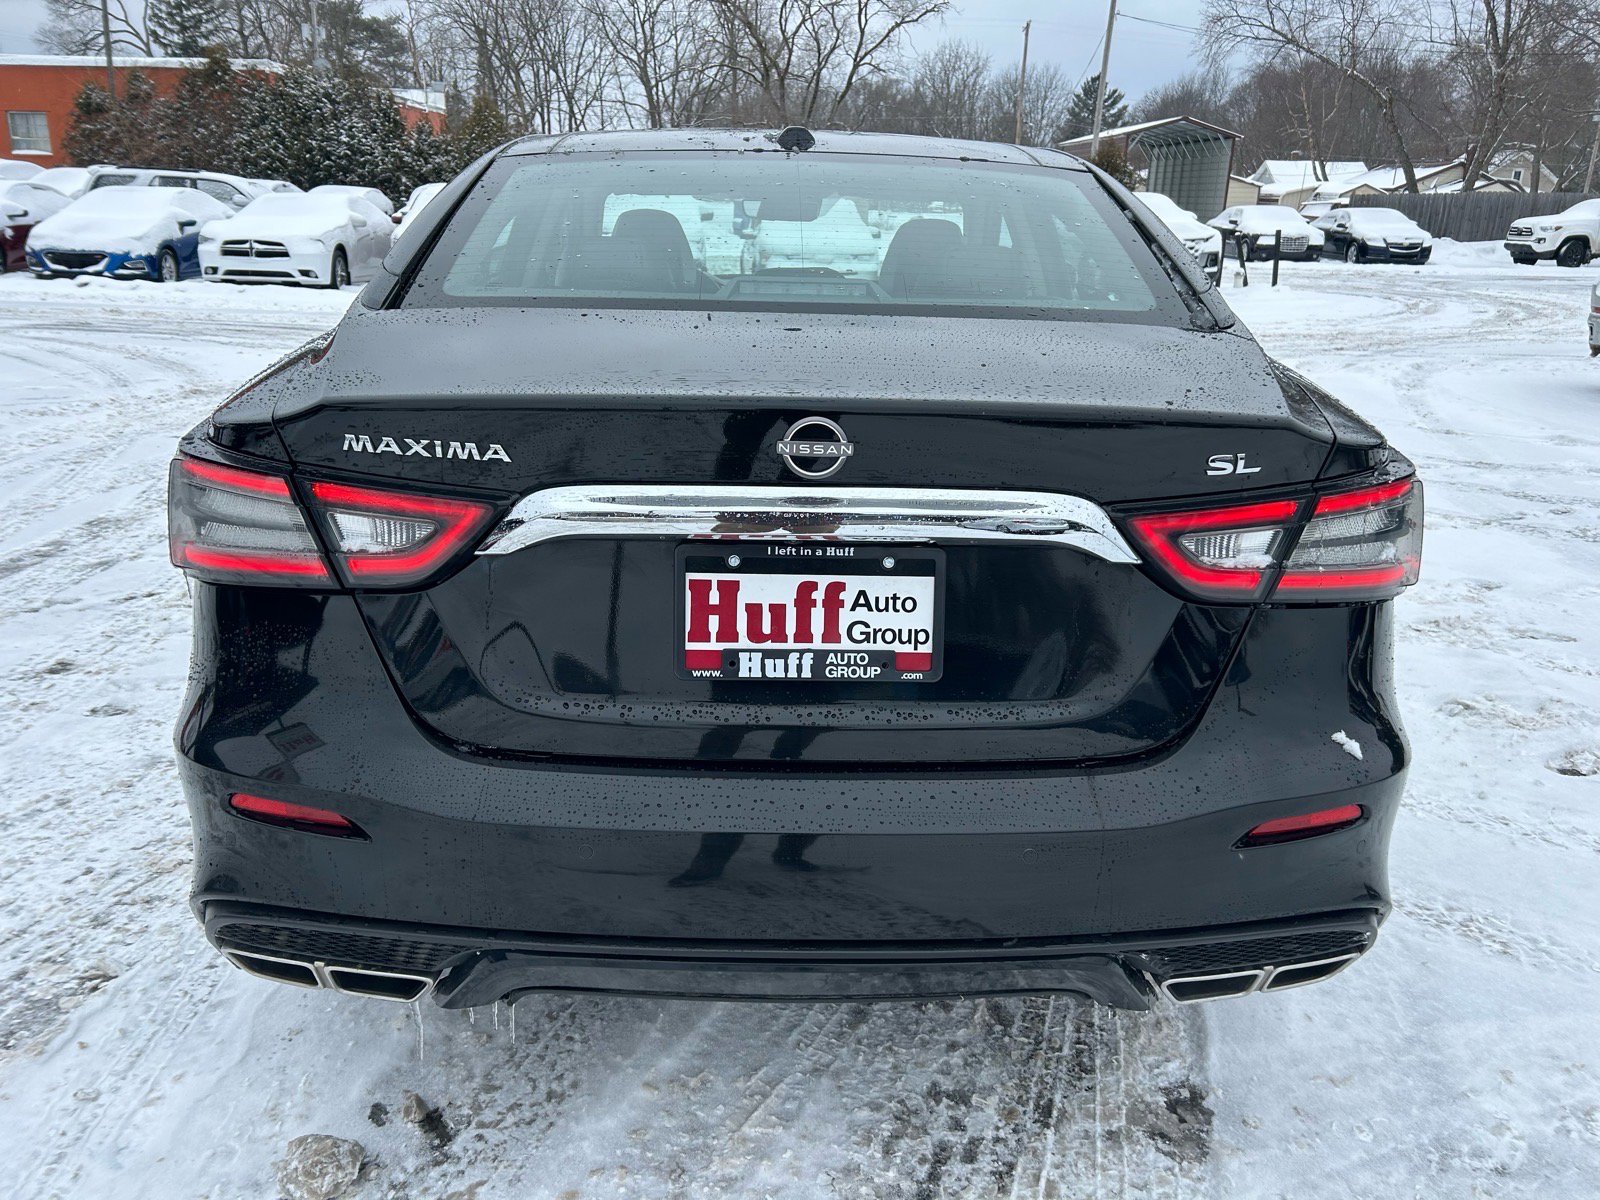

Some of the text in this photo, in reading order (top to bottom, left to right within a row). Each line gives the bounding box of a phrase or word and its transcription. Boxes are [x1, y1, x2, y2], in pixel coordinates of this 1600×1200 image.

[342, 433, 512, 463] MAXIMA
[778, 443, 852, 455] NISSAN
[1206, 453, 1262, 476] SL
[767, 546, 854, 556] I left in a Huff
[687, 578, 847, 644] Huff
[849, 589, 918, 613] Auto
[846, 620, 930, 651] Group
[692, 652, 814, 678] www. Huff
[826, 653, 869, 665] AUTO
[825, 665, 881, 679] GROUP
[900, 671, 923, 680] .com
